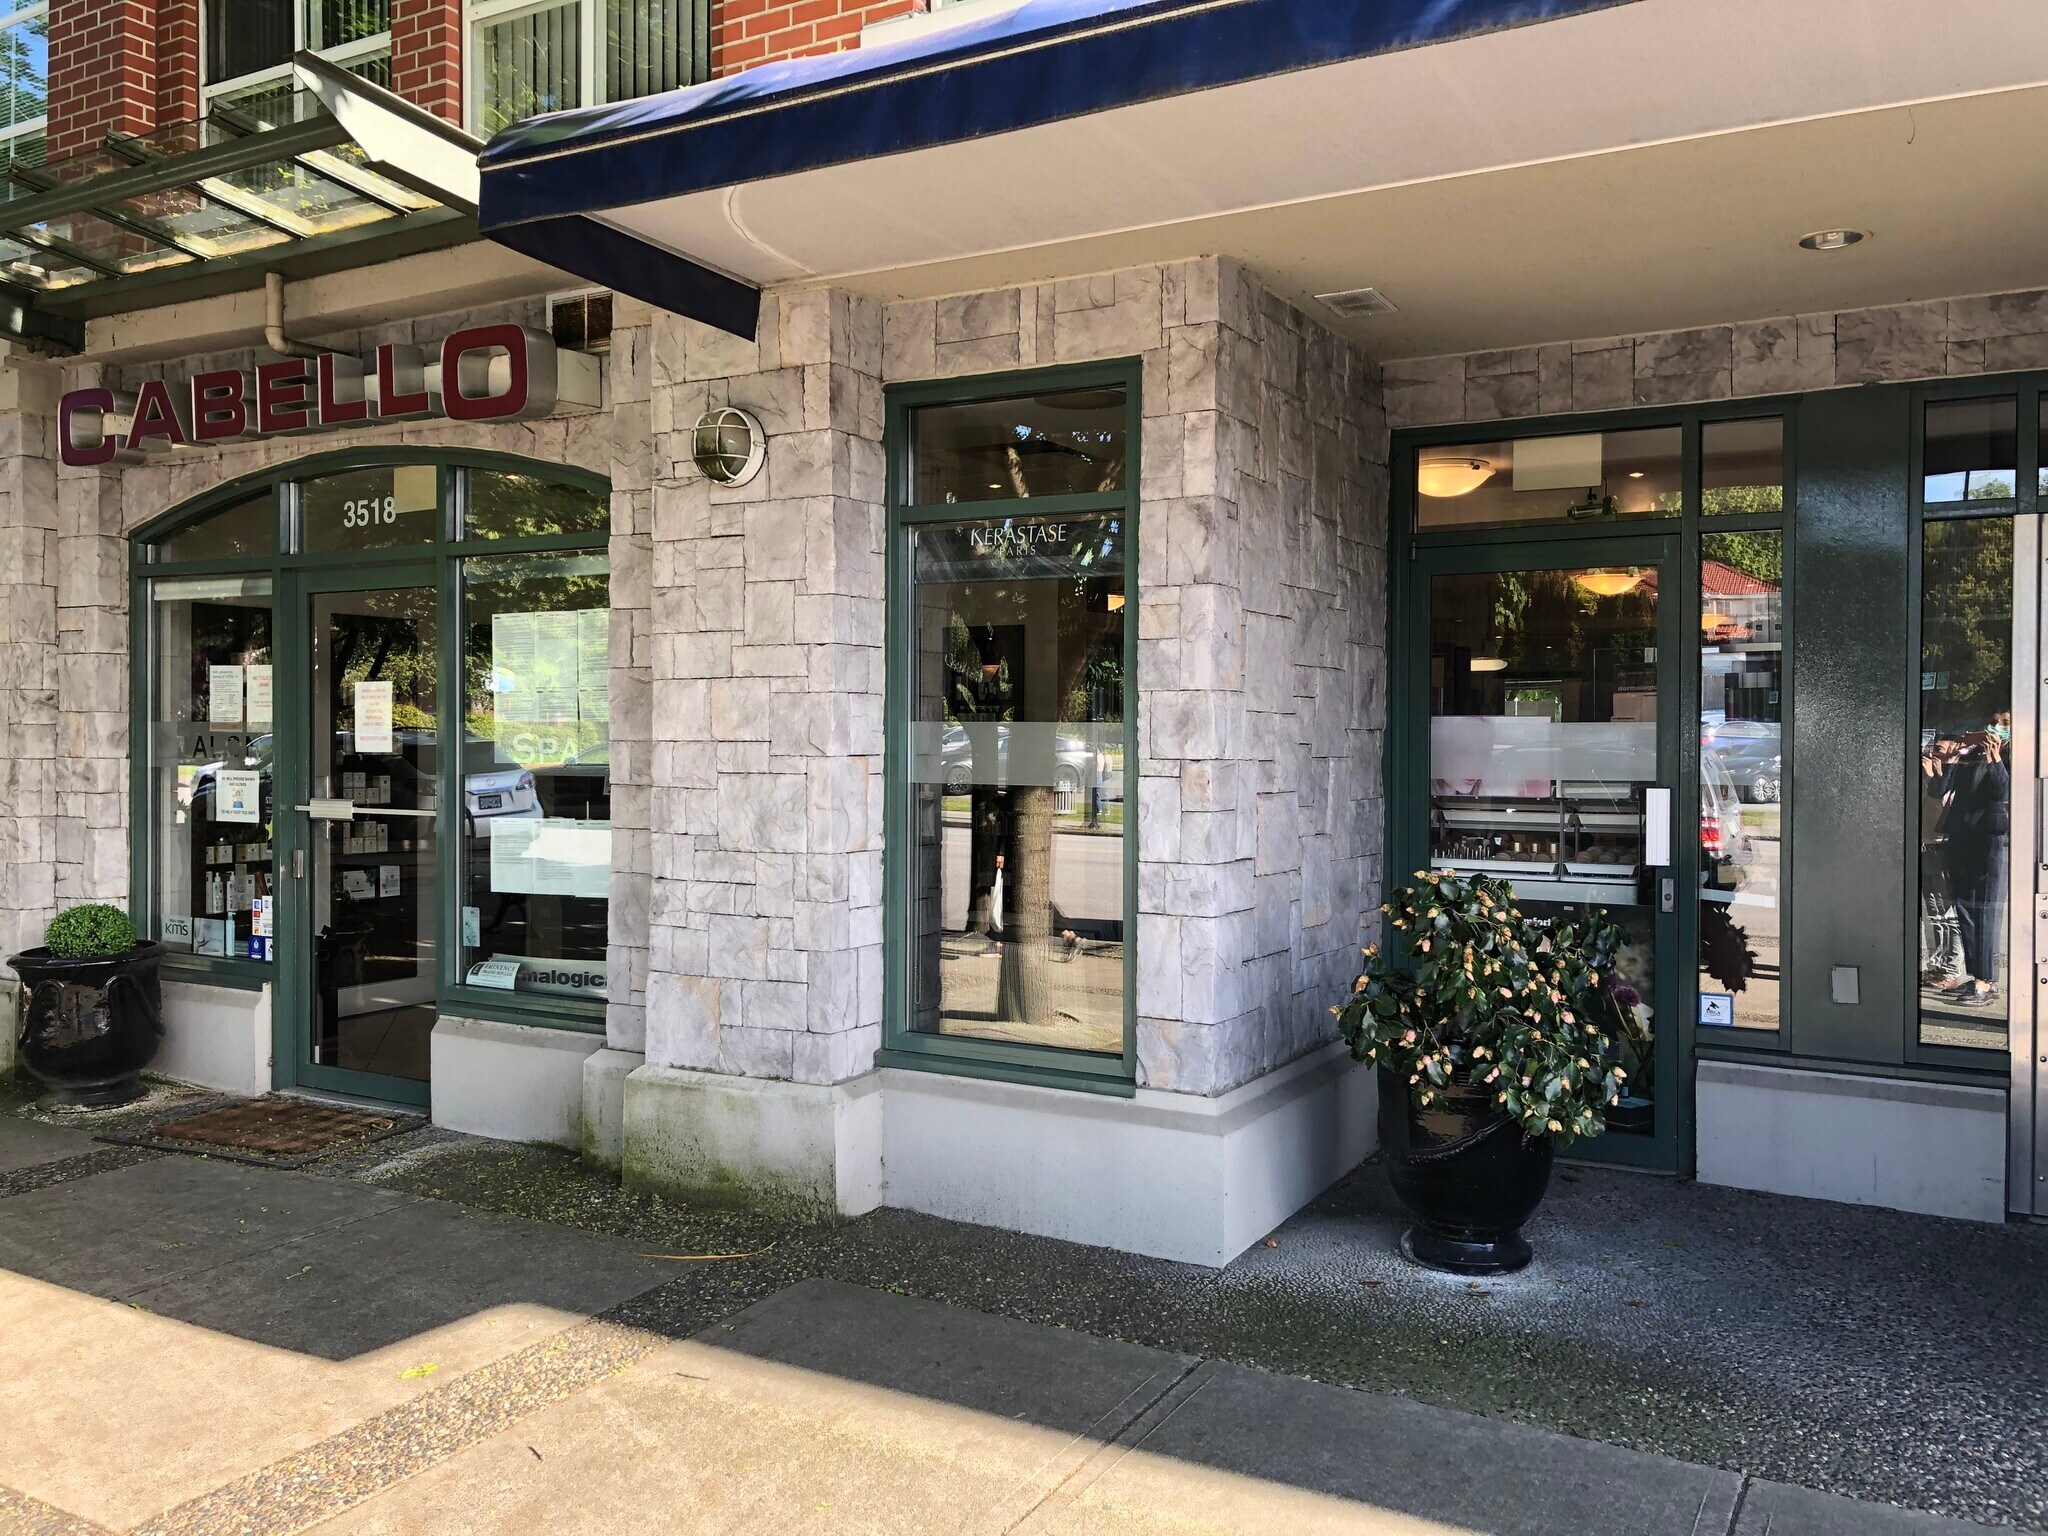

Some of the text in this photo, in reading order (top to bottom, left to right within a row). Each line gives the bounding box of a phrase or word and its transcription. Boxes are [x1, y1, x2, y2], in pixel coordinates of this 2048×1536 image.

[57, 323, 529, 466] CABELLO
[343, 496, 396, 528] 3518
[1000, 545, 1036, 556] PARIS
[513, 733, 579, 765] SPA
